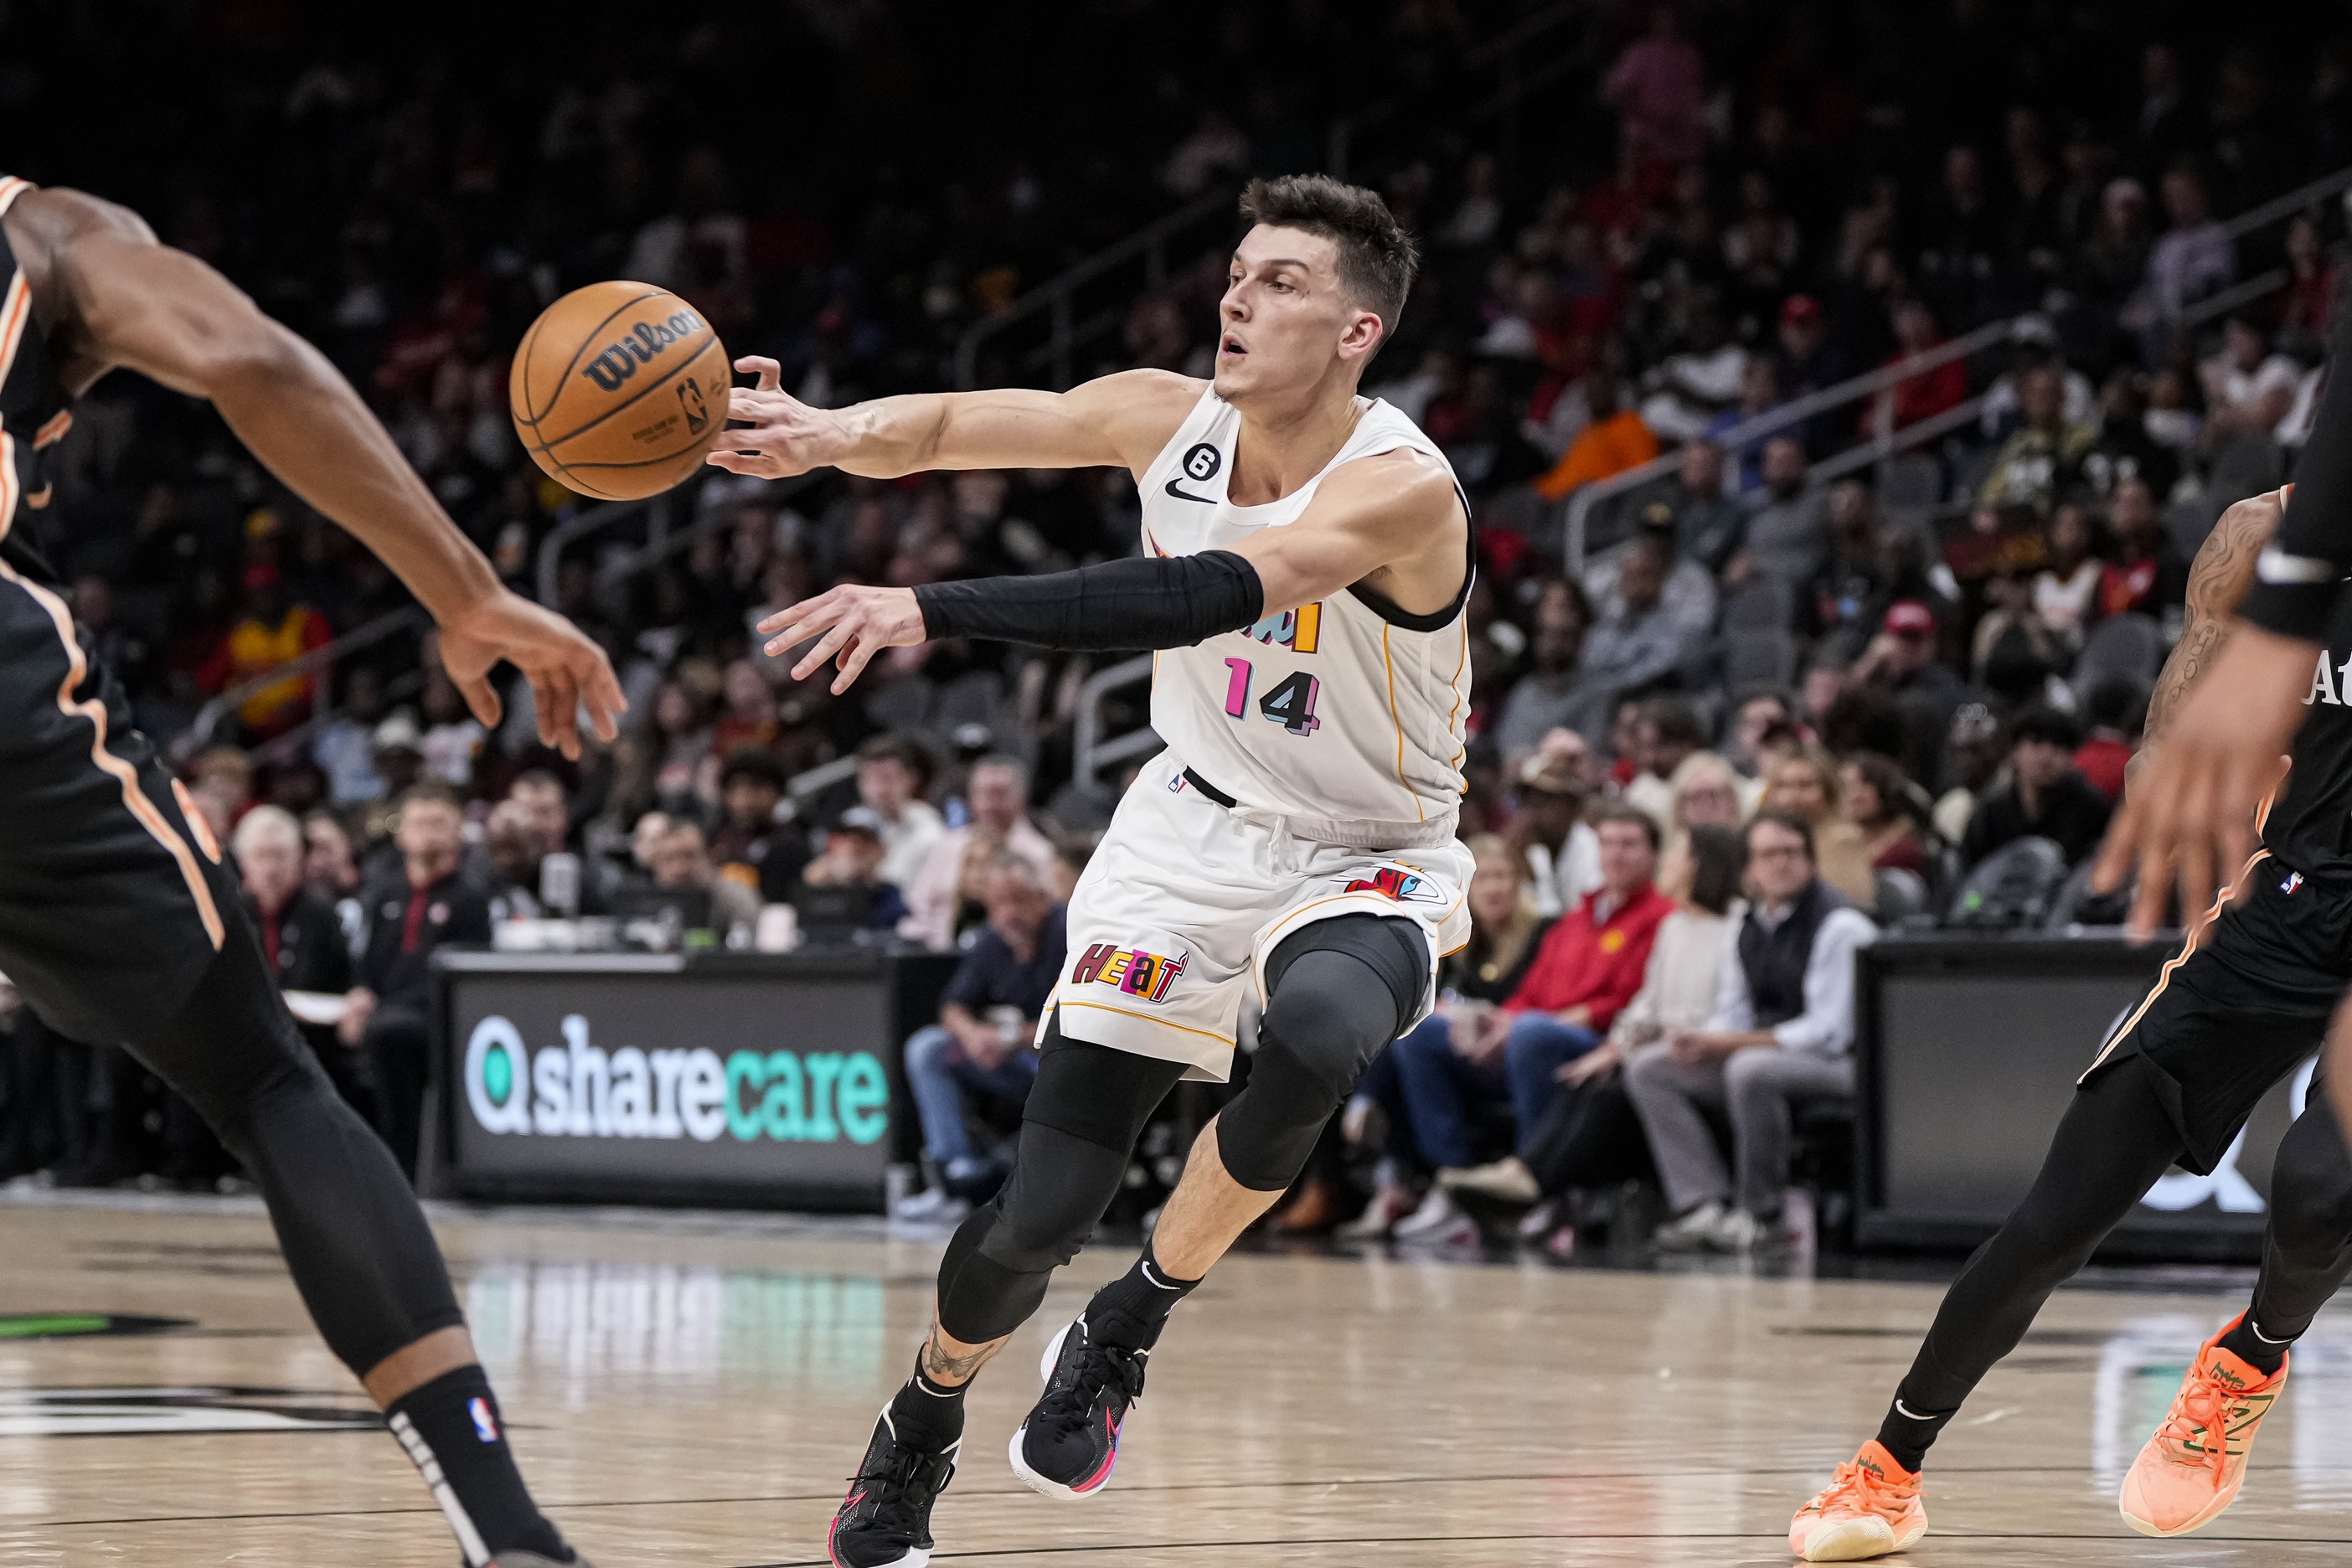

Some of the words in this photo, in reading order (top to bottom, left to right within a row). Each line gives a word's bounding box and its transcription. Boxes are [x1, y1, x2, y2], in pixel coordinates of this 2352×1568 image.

[581, 309, 705, 392] Wilson
[1188, 447, 1216, 477] 6
[1225, 657, 1321, 737] 14
[533, 1014, 890, 1144] sharecare
